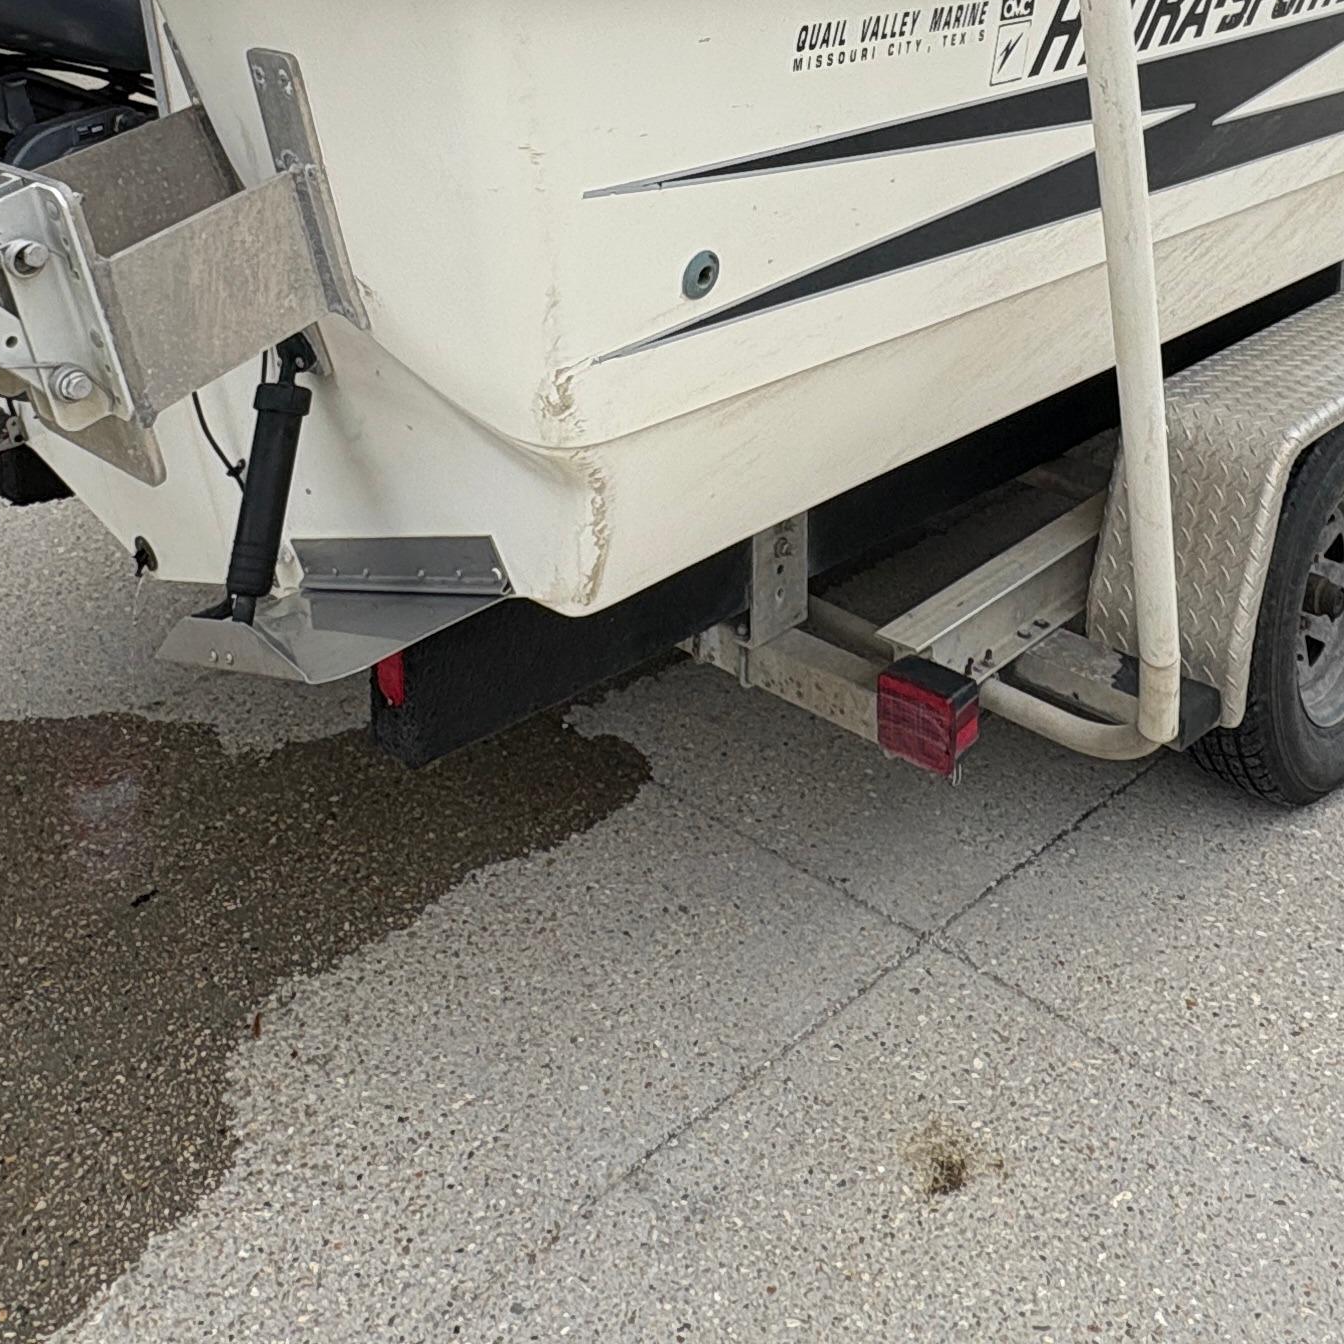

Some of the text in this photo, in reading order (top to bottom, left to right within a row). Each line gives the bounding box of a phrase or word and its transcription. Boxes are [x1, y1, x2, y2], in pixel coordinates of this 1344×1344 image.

[796, 0, 990, 53] QUAIL VALLEY MARINE
[792, 46, 876, 72] MISSOURI
[887, 39, 932, 56] CITY,
